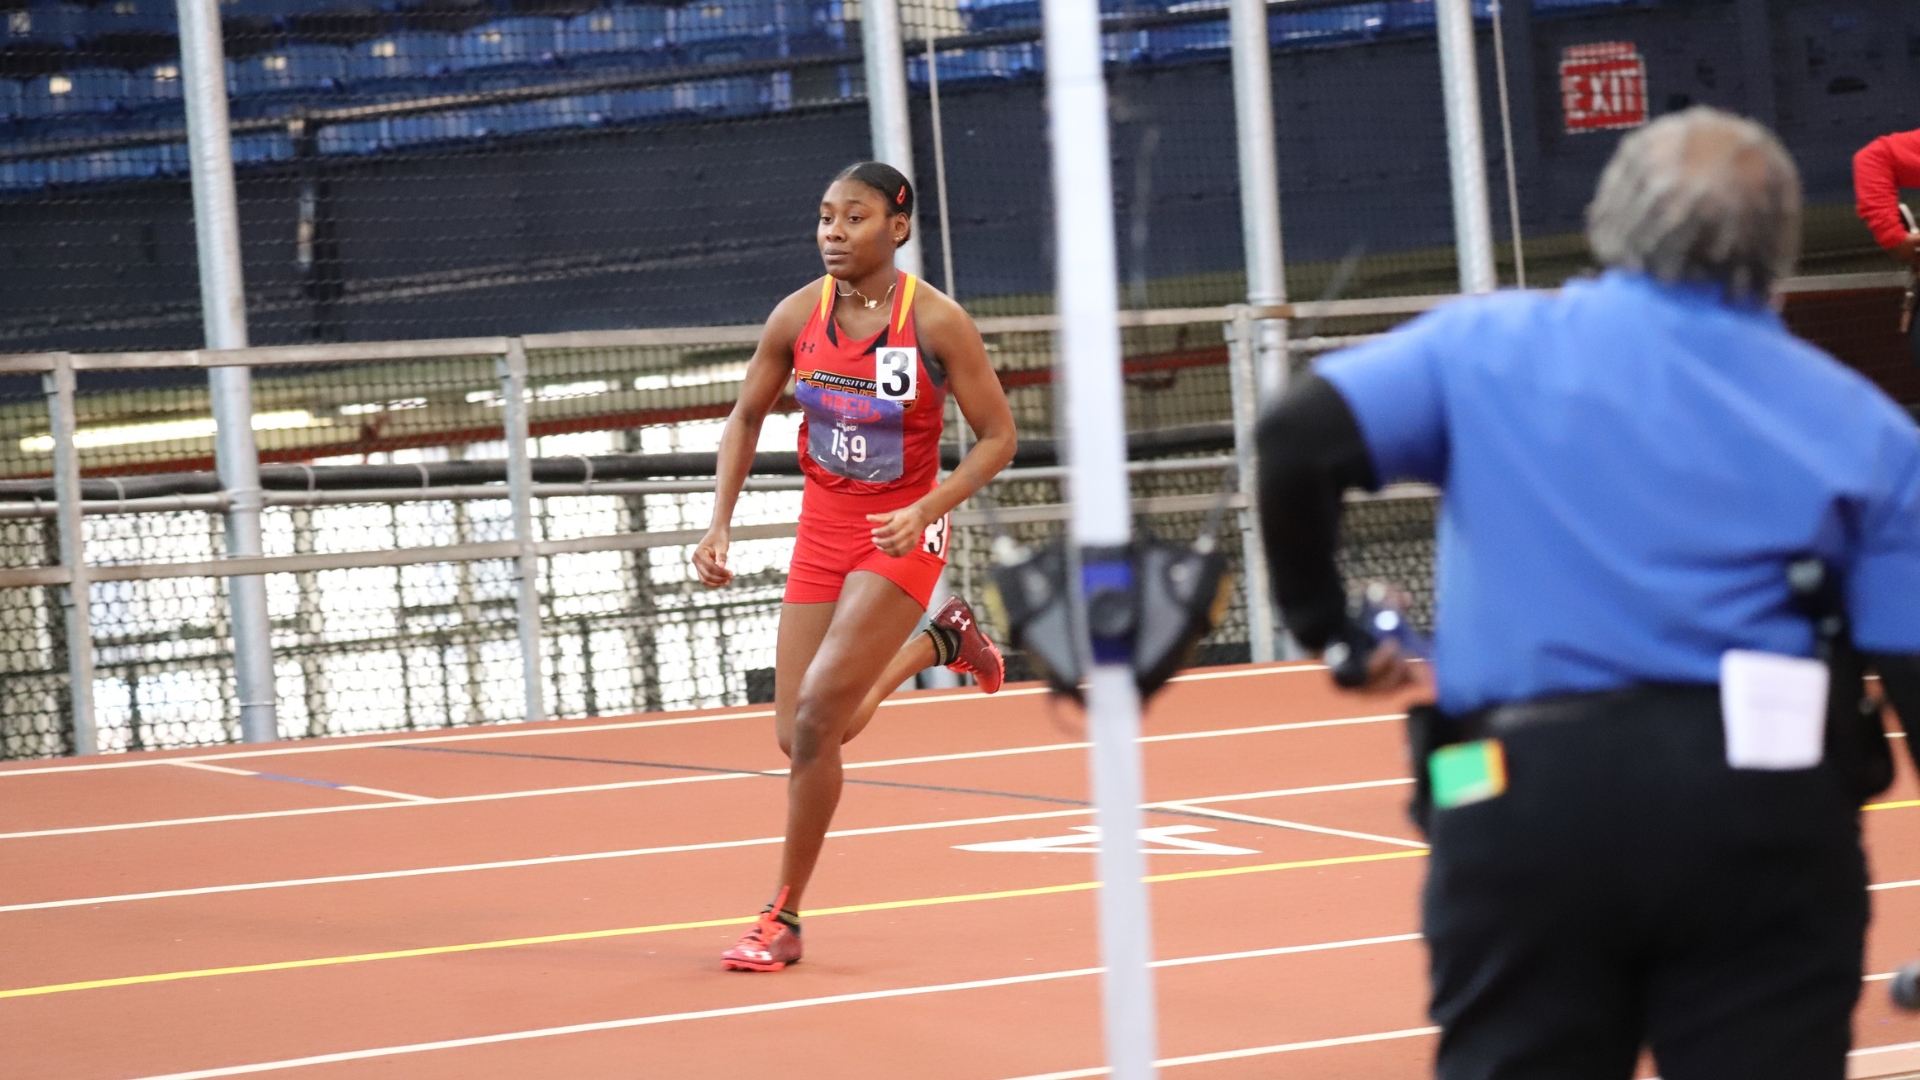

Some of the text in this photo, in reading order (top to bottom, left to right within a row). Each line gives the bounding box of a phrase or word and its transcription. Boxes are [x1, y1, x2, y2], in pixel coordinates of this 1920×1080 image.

[1562, 68, 1638, 119] EXIT
[813, 372, 866, 388] UNIVERSITY
[882, 351, 910, 396] 3
[821, 392, 871, 413] HBCU
[831, 429, 867, 463] 159
[928, 514, 945, 556] 3
